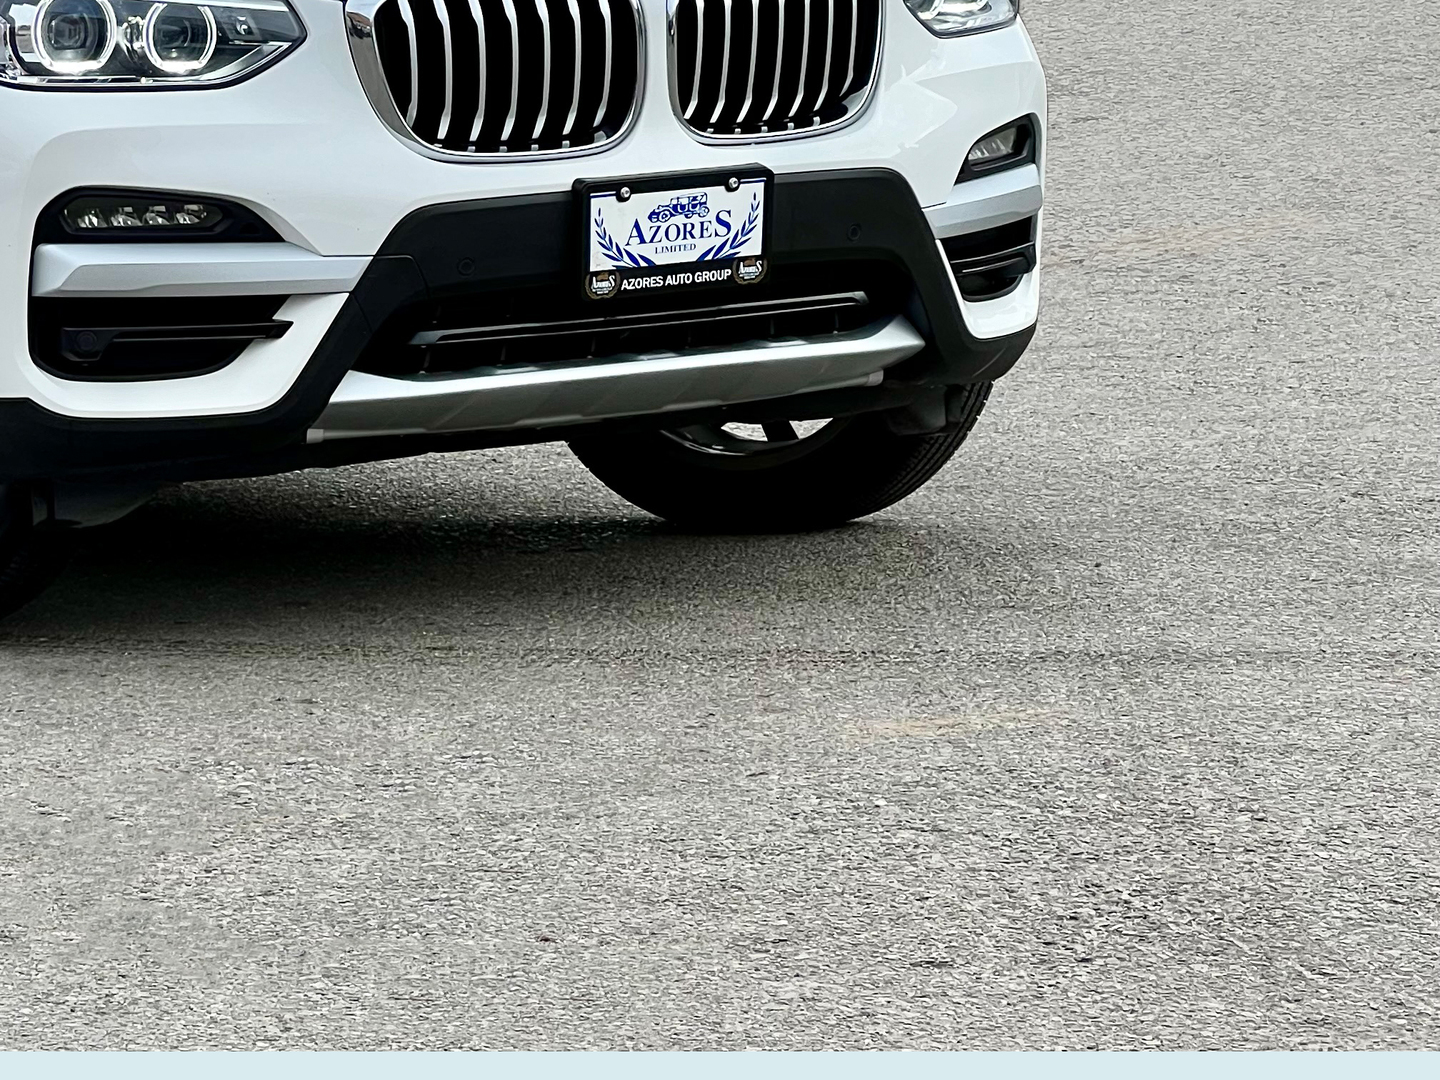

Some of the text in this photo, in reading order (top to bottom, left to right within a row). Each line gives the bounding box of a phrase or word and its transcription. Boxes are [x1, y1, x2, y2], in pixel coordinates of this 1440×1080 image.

[624, 209, 733, 247] AZORES
[654, 243, 697, 255] LIMITED
[621, 275, 664, 291] AZORES
[665, 273, 693, 286] AUTO
[694, 268, 732, 283] GROUP
